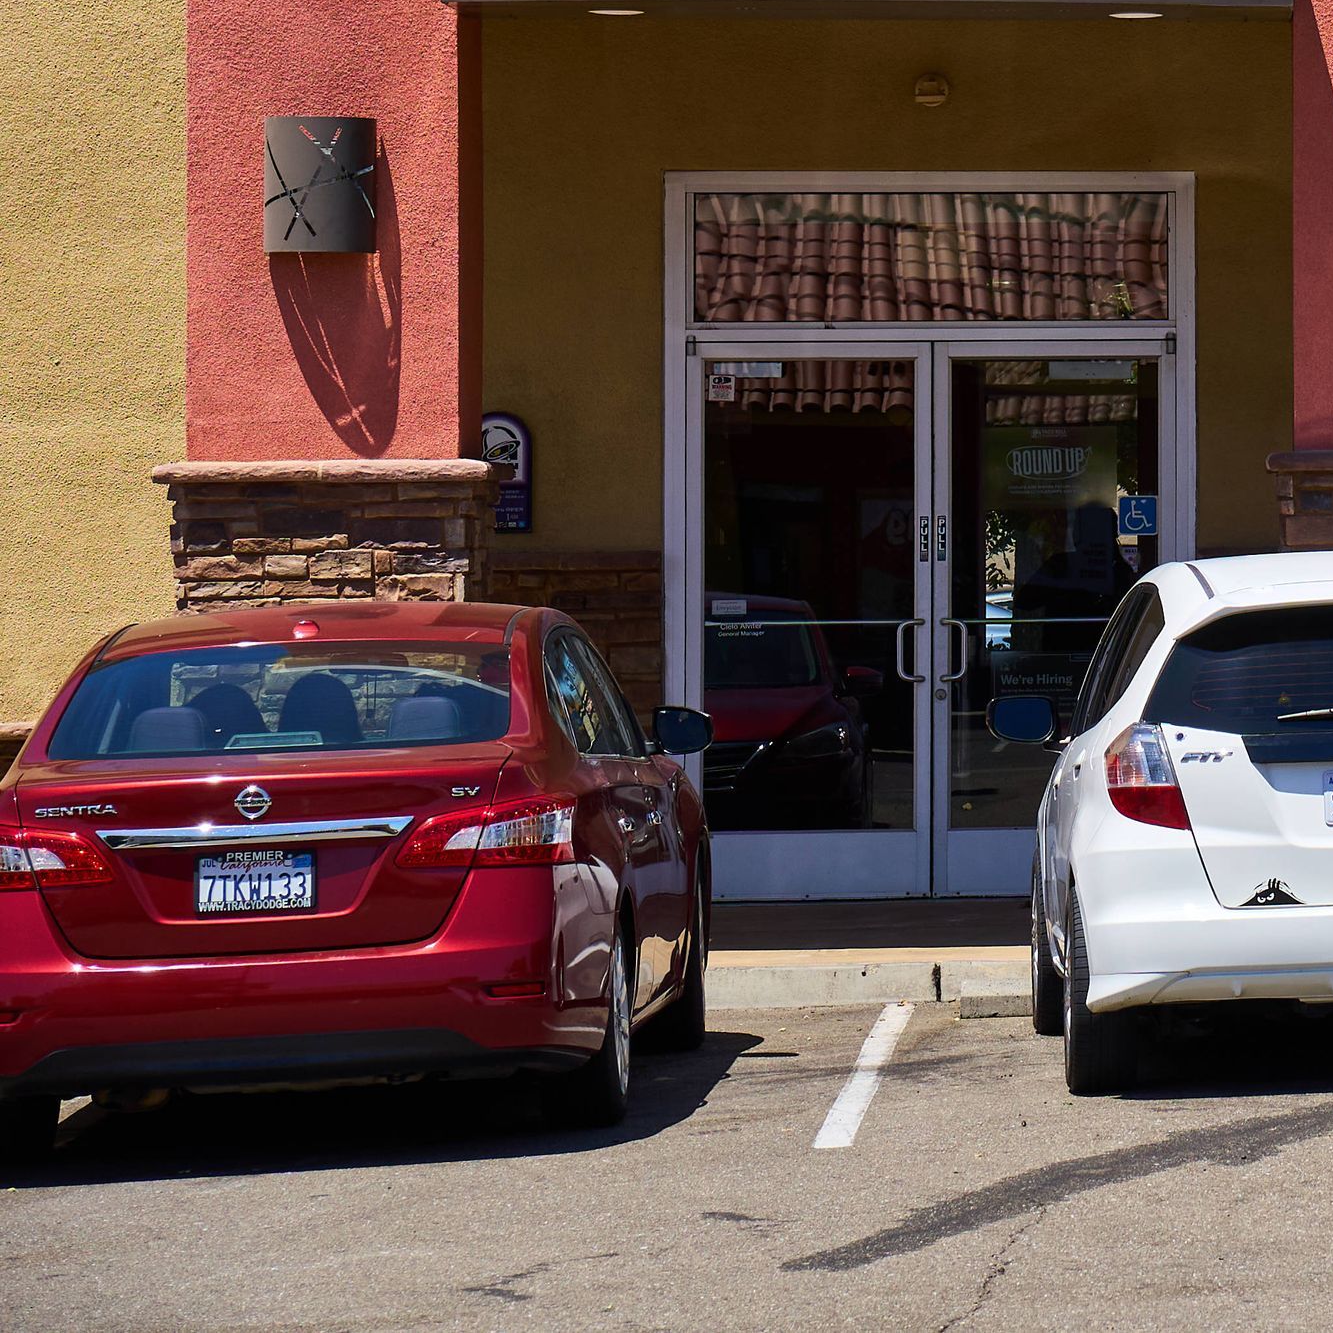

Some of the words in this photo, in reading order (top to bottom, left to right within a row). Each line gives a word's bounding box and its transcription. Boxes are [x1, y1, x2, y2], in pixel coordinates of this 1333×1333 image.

[1012, 448, 1062, 476] ROUND
[1064, 447, 1084, 473] UP
[920, 519, 928, 551] PULL
[938, 518, 946, 551] PULL
[1000, 674, 1034, 685] We're
[1036, 673, 1073, 686] Hiring
[451, 786, 480, 797] SV
[35, 804, 118, 818] SENTRA
[226, 850, 284, 862] PREMIER
[202, 859, 216, 868] JUL
[203, 872, 307, 903] 7TKW133
[198, 897, 312, 912] WWW.TRACYDODGE.COM
